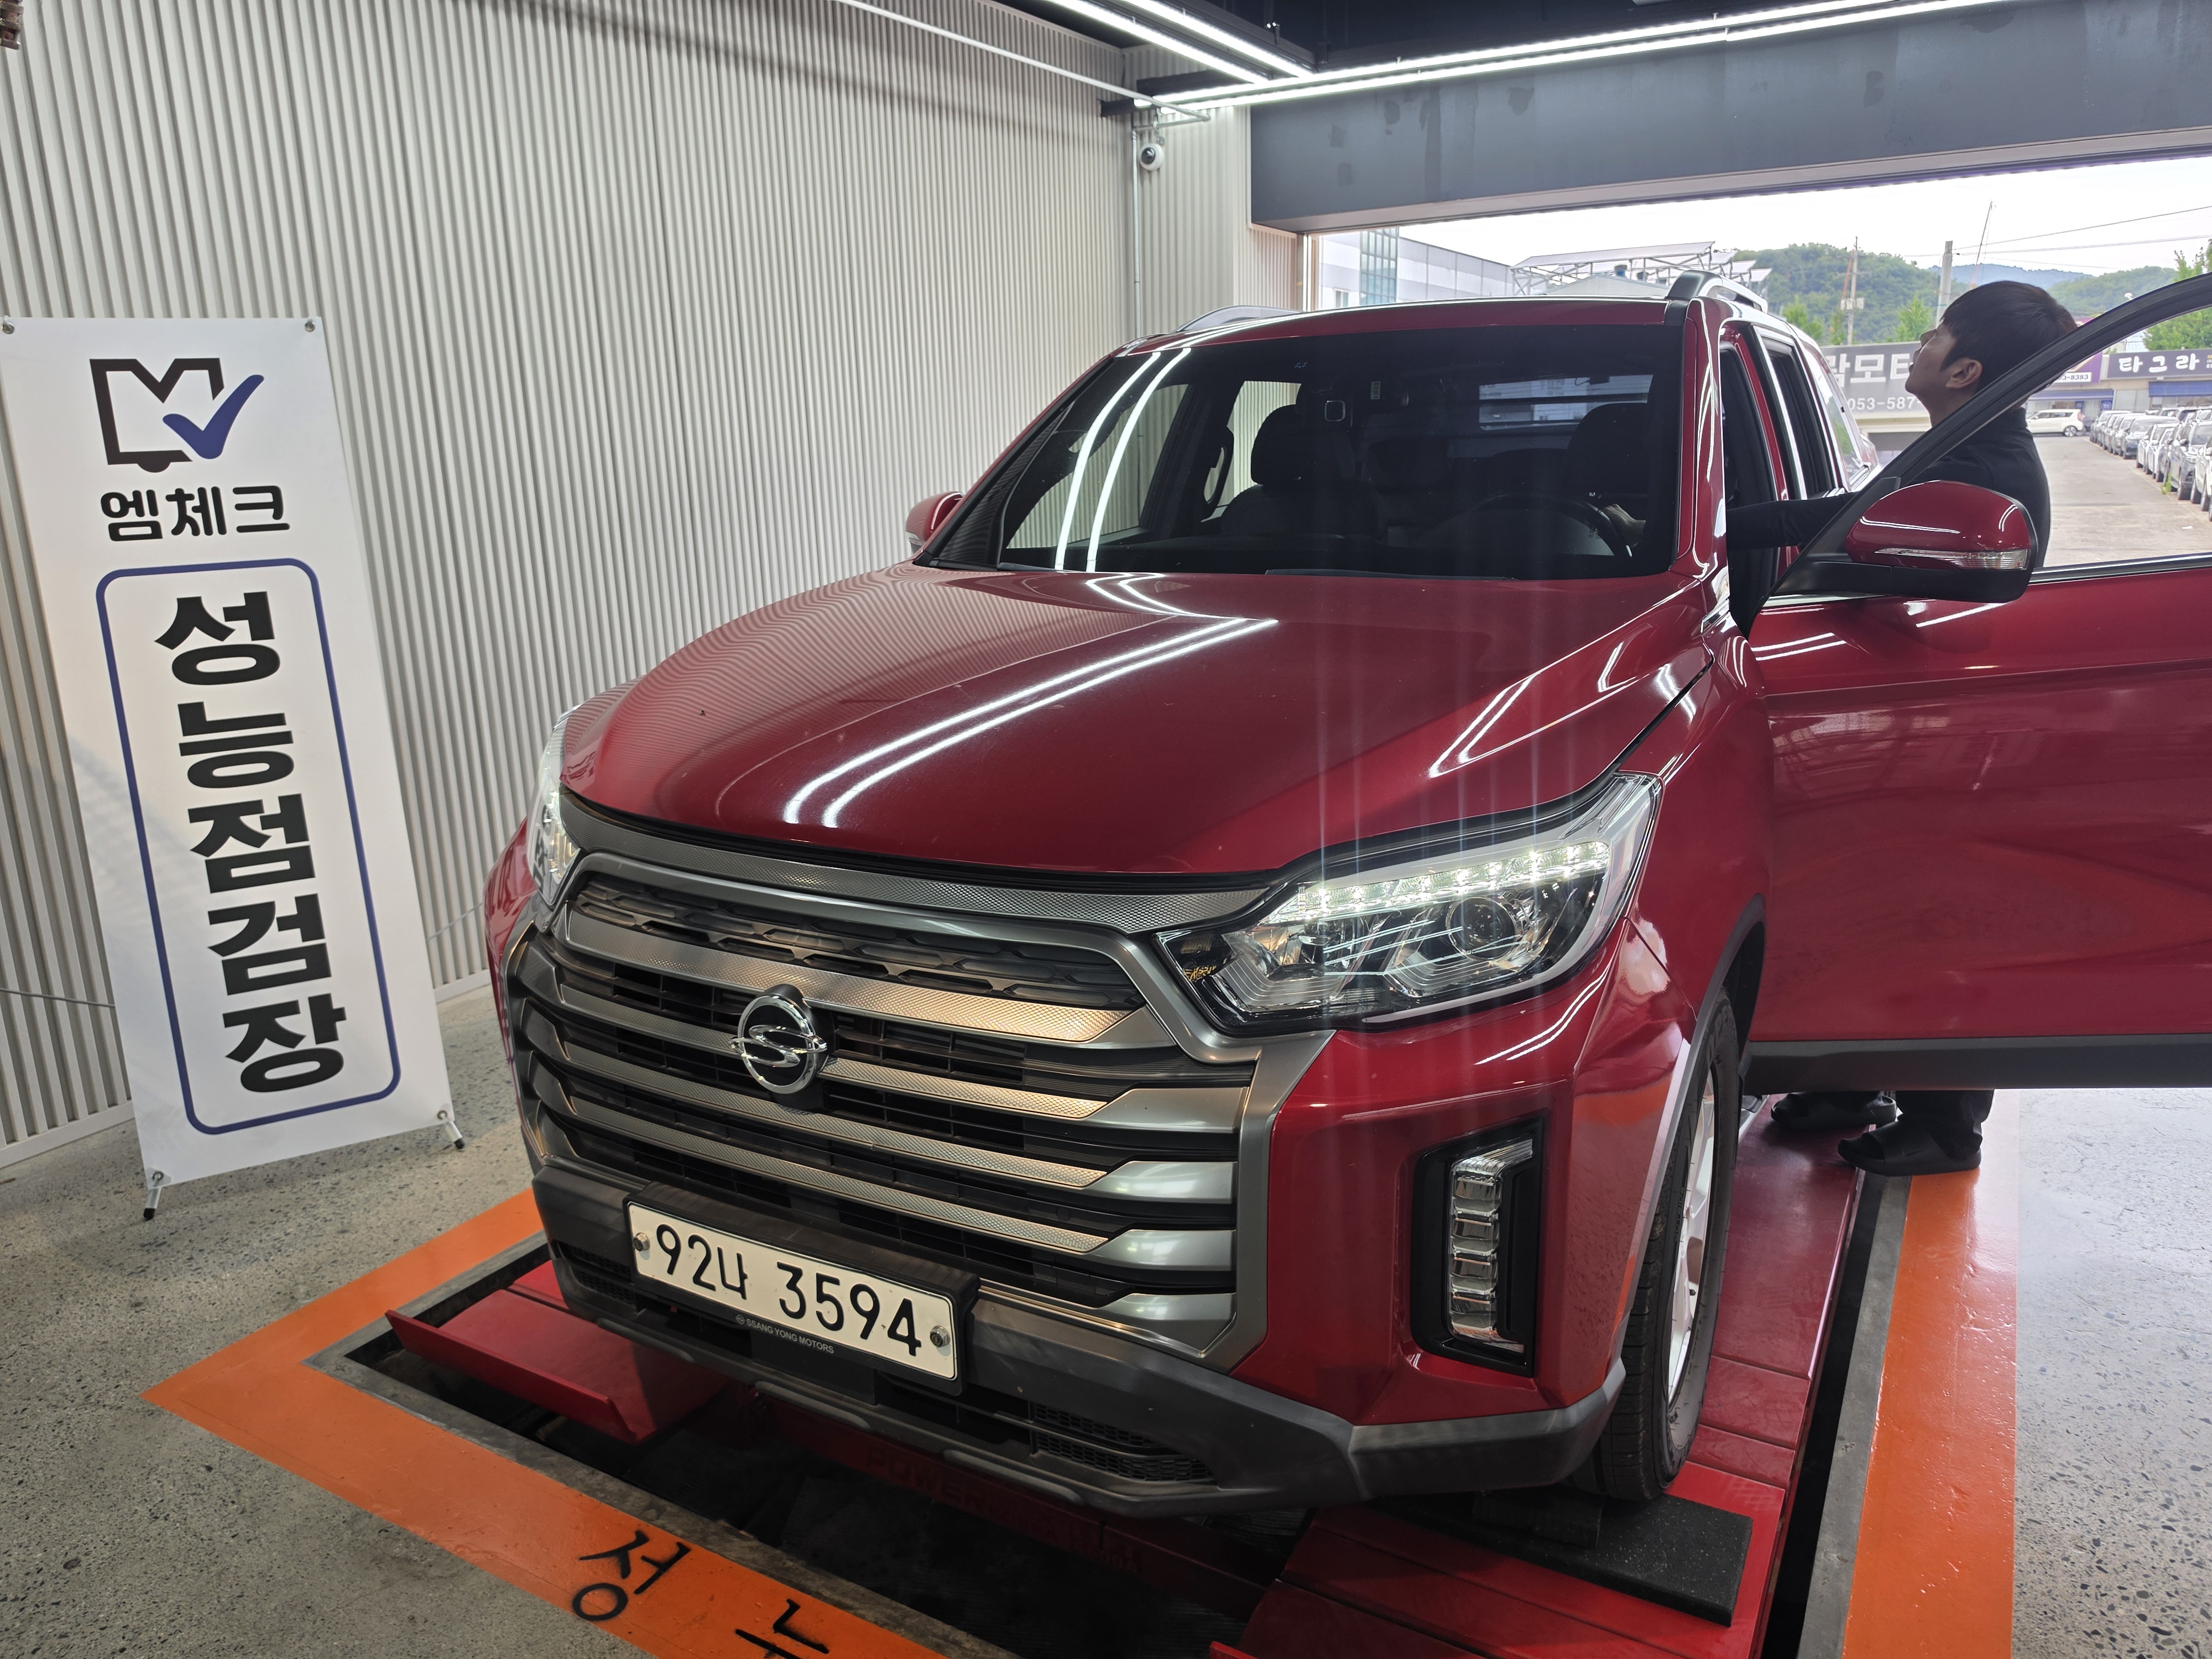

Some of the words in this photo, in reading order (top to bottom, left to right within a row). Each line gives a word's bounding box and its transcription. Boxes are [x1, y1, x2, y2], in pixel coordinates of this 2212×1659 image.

[2119, 353, 2200, 373] 타그라
[100, 485, 290, 542] 엠체크
[154, 591, 347, 1093] 성능점검장
[656, 1223, 748, 1300] 92나
[776, 1261, 922, 1357] 3594
[746, 1318, 774, 1334] SSANG
[774, 1327, 798, 1342] YONG
[799, 1335, 834, 1354] MOTORS
